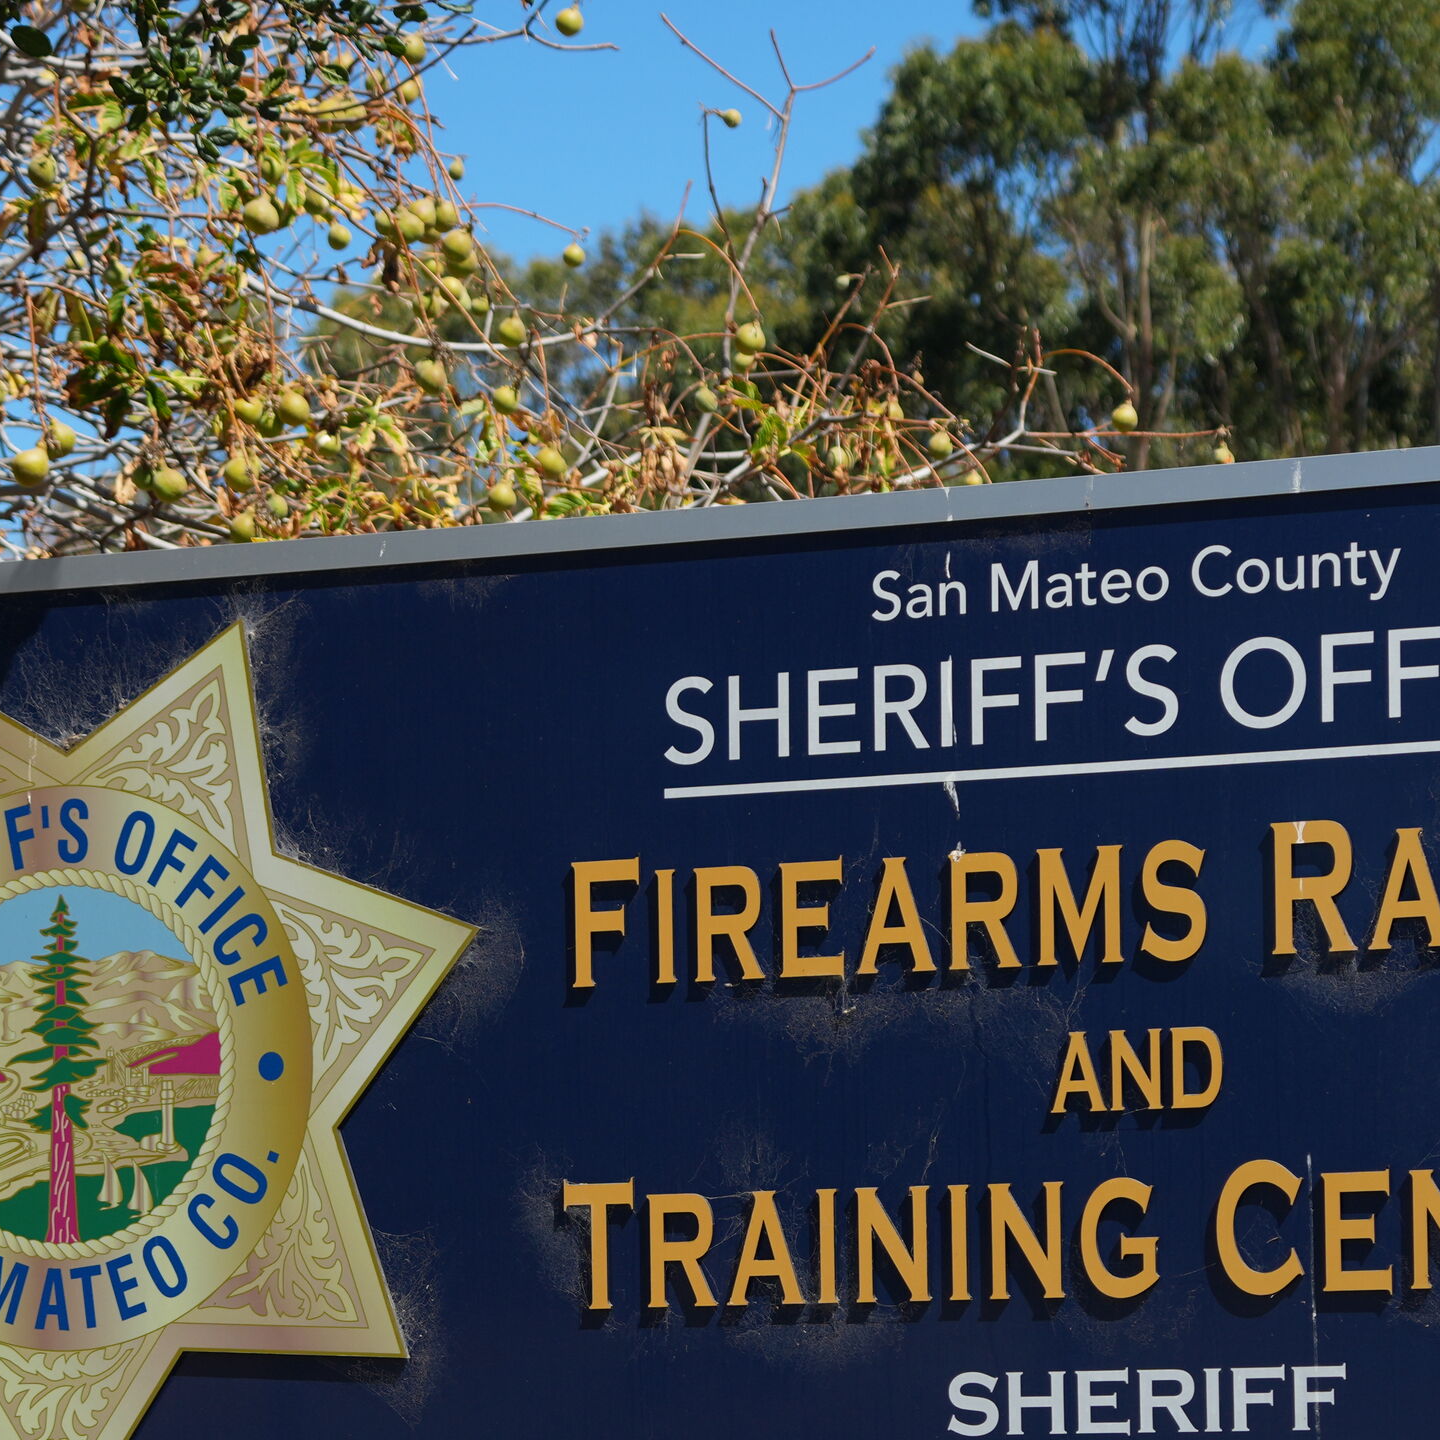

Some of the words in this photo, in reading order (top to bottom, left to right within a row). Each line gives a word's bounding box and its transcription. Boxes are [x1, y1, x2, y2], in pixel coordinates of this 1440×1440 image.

[872, 571, 967, 621] San
[992, 560, 1169, 613] Mateo
[1192, 541, 1402, 601] County
[664, 645, 1179, 766] SHERIFF'S
[114, 811, 288, 1006] OFFICE
[571, 839, 1207, 989] FIREARMS
[1051, 1026, 1224, 1114] AND
[187, 1150, 279, 1249] CO.
[563, 1177, 1160, 1310] TRAINING
[947, 1362, 1347, 1437] SHERIFF
